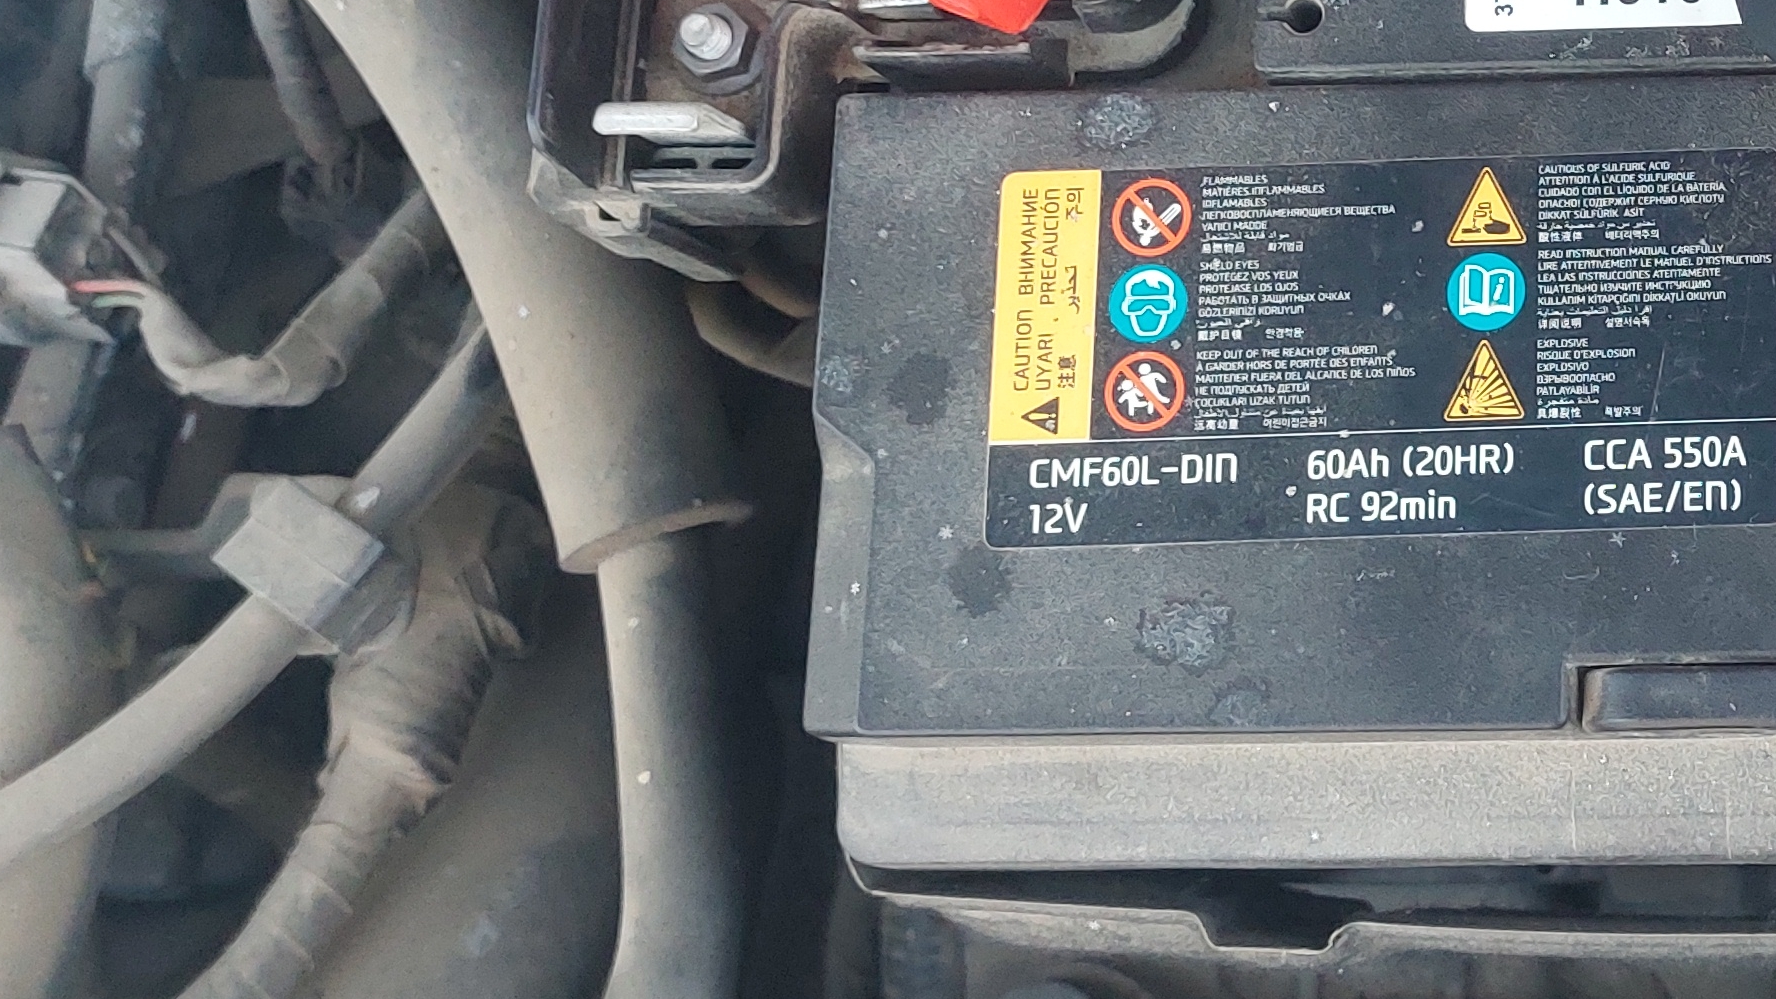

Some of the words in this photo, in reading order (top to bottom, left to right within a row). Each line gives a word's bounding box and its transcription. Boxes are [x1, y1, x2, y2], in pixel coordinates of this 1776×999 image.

[1538, 162, 1584, 174] CAUTIOUS
[1586, 162, 1600, 172] OF
[1602, 161, 1646, 172] SULFURIC
[1648, 160, 1671, 171] ACID
[1201, 174, 1268, 186] FLAMMABLES
[1538, 174, 1590, 186] ATTENTION
[1637, 171, 1695, 183] SULFURIQUE
[1538, 186, 1579, 197] CUIDADO
[1581, 185, 1601, 196] CON
[1603, 185, 1615, 195] EL
[1657, 183, 1670, 194] DE
[1671, 182, 1684, 193] LA
[1018, 188, 1039, 295] ВНИМАНИЕ
[1039, 188, 1061, 305] PRECAUCIÓN
[1537, 248, 1562, 259] READ
[1565, 246, 1626, 259] INSTRUCTION
[1628, 245, 1668, 257] MANUAL
[1671, 243, 1723, 255] CAREFULLY
[1234, 257, 1259, 270] EYES
[1537, 260, 1557, 271] LIRE
[1560, 257, 1637, 271] ATTENTIVEMENT
[1639, 257, 1651, 268] LE
[1654, 256, 1693, 268] MANUEL
[1251, 270, 1270, 281] VOS
[1272, 269, 1298, 280] YEUX
[1537, 272, 1555, 282] LEA
[1558, 271, 1575, 282] LAS
[1578, 269, 1649, 281] INSTRUCCIONES
[1253, 282, 1272, 293] LOS
[1537, 293, 1584, 306] KULLANIM
[1686, 289, 1726, 301] OKUYUN
[1536, 337, 1588, 348] EXPLOSIVE
[1013, 309, 1034, 392] CAUTION
[1196, 349, 1221, 360] KEEP
[1223, 348, 1242, 359] OUT
[1245, 348, 1258, 359] OF
[1260, 347, 1279, 358] THE
[1282, 346, 1313, 358] REACH
[1315, 346, 1329, 357] OF
[1331, 344, 1377, 356] CHILDREN
[1035, 333, 1053, 391] UYARI
[1205, 360, 1243, 371] GARDER
[1246, 359, 1272, 370] HORS
[1274, 358, 1287, 369] DE
[1329, 357, 1348, 367] DES
[1350, 355, 1393, 367] ENFANTS
[1536, 360, 1589, 372] EXPLOSIVO
[1057, 354, 1076, 389] 注意
[1251, 371, 1281, 382] FUERA
[1284, 370, 1302, 381] DEL
[1350, 368, 1362, 379] DE
[1365, 368, 1383, 379] LOS
[1249, 395, 1275, 407] UZAK
[1278, 394, 1310, 406] TUTUN
[1584, 438, 1653, 471] CCA
[1663, 435, 1747, 468] 550A
[1307, 448, 1389, 480] 60Ah
[1402, 442, 1515, 477] (20HR)
[1306, 492, 1349, 524] RC
[1360, 489, 1456, 522] 92min
[1030, 503, 1087, 534] 12V
